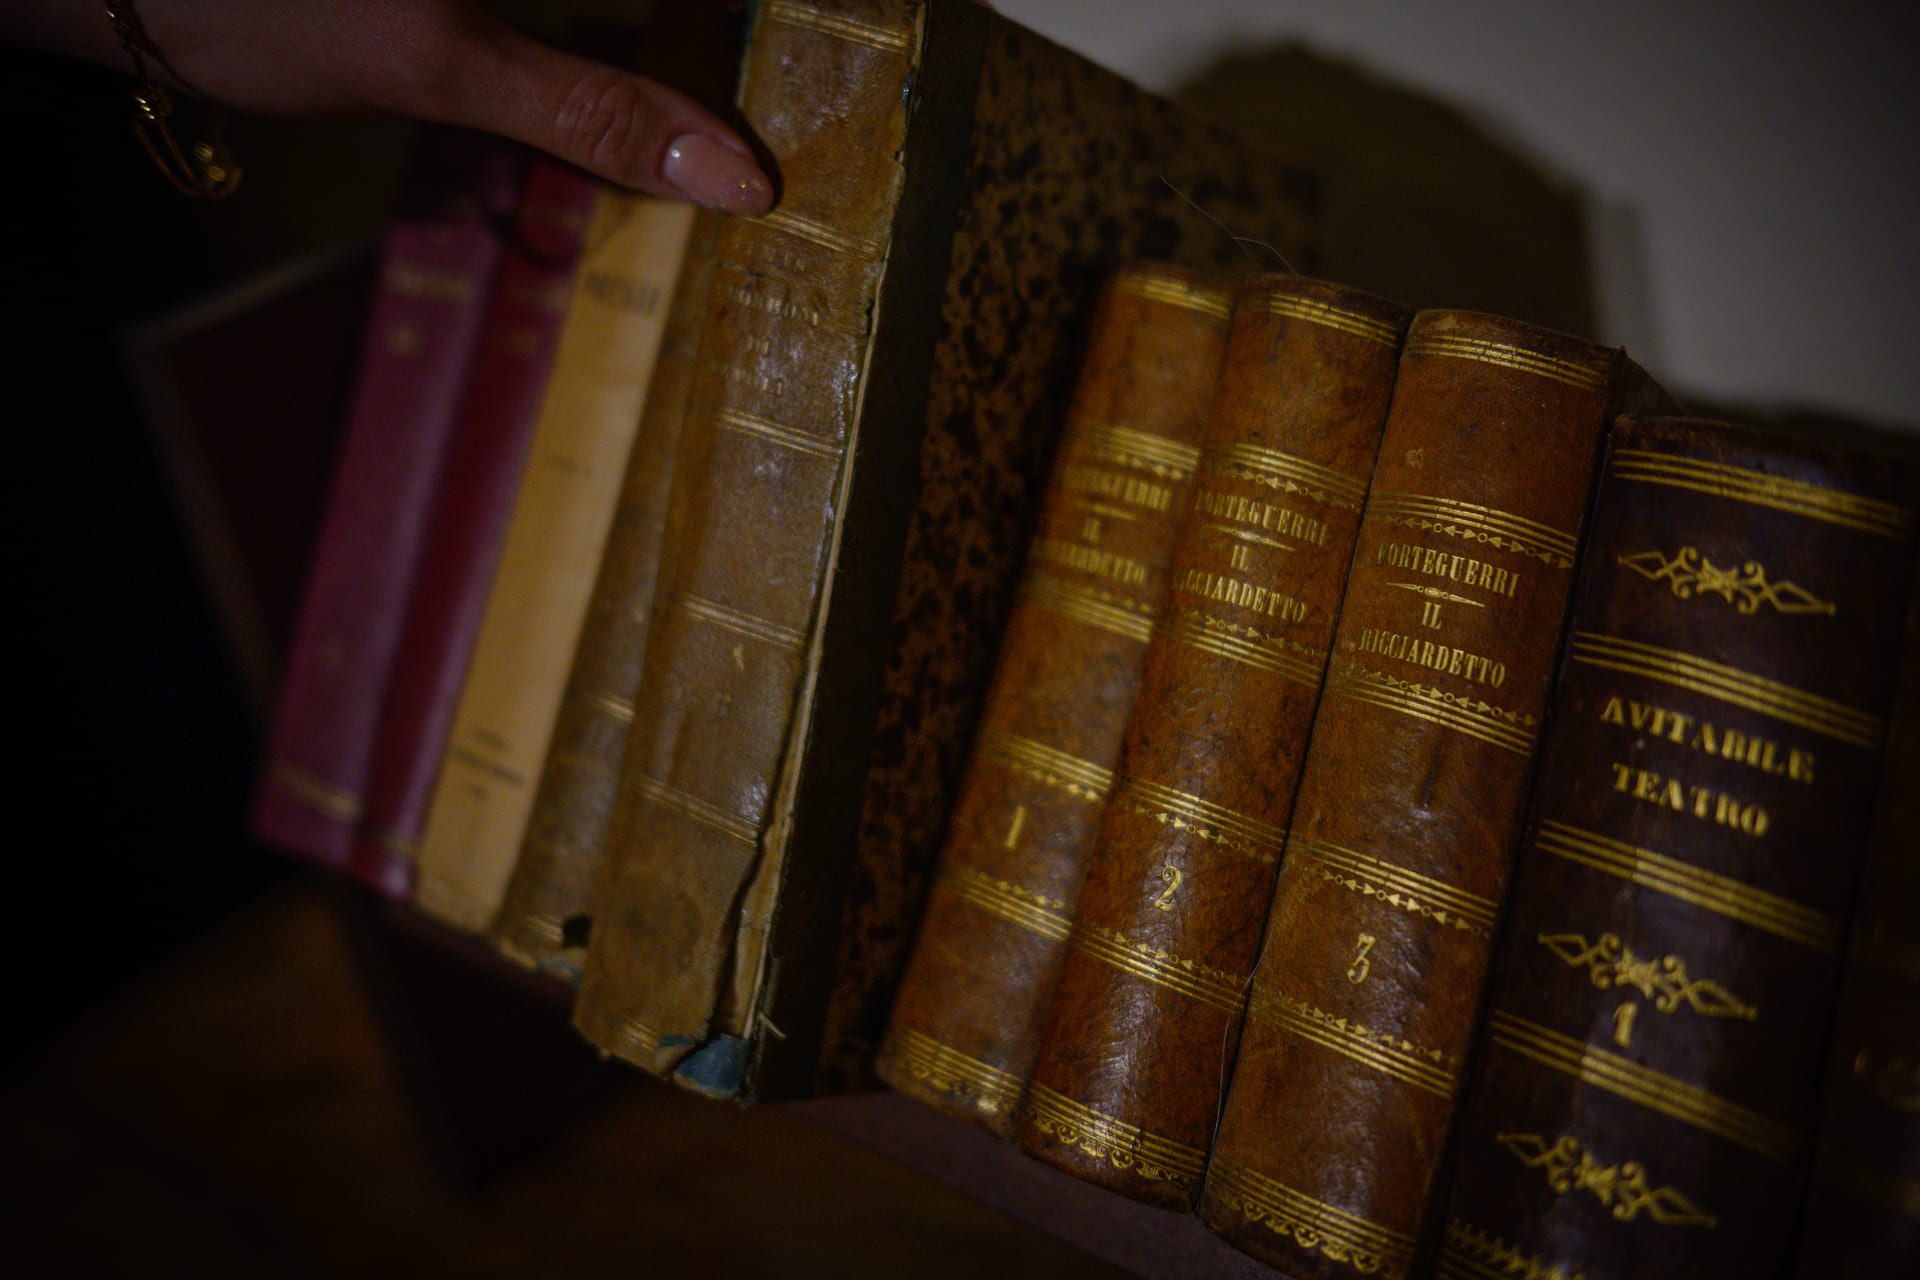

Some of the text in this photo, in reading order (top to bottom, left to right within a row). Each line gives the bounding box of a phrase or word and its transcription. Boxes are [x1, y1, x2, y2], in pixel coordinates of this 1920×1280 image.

[1230, 544, 1250, 572] IL
[1376, 542, 1520, 598] FORTEGUERRI
[1421, 602, 1443, 630] IL
[1358, 626, 1506, 688] RICCIARDETTO
[1600, 696, 1815, 785] AVITABILE
[1612, 761, 1770, 837] TEATRO
[1003, 804, 1027, 849] 1
[1154, 866, 1182, 912] 2
[1347, 931, 1376, 985] 3
[1612, 1001, 1638, 1048] 1
